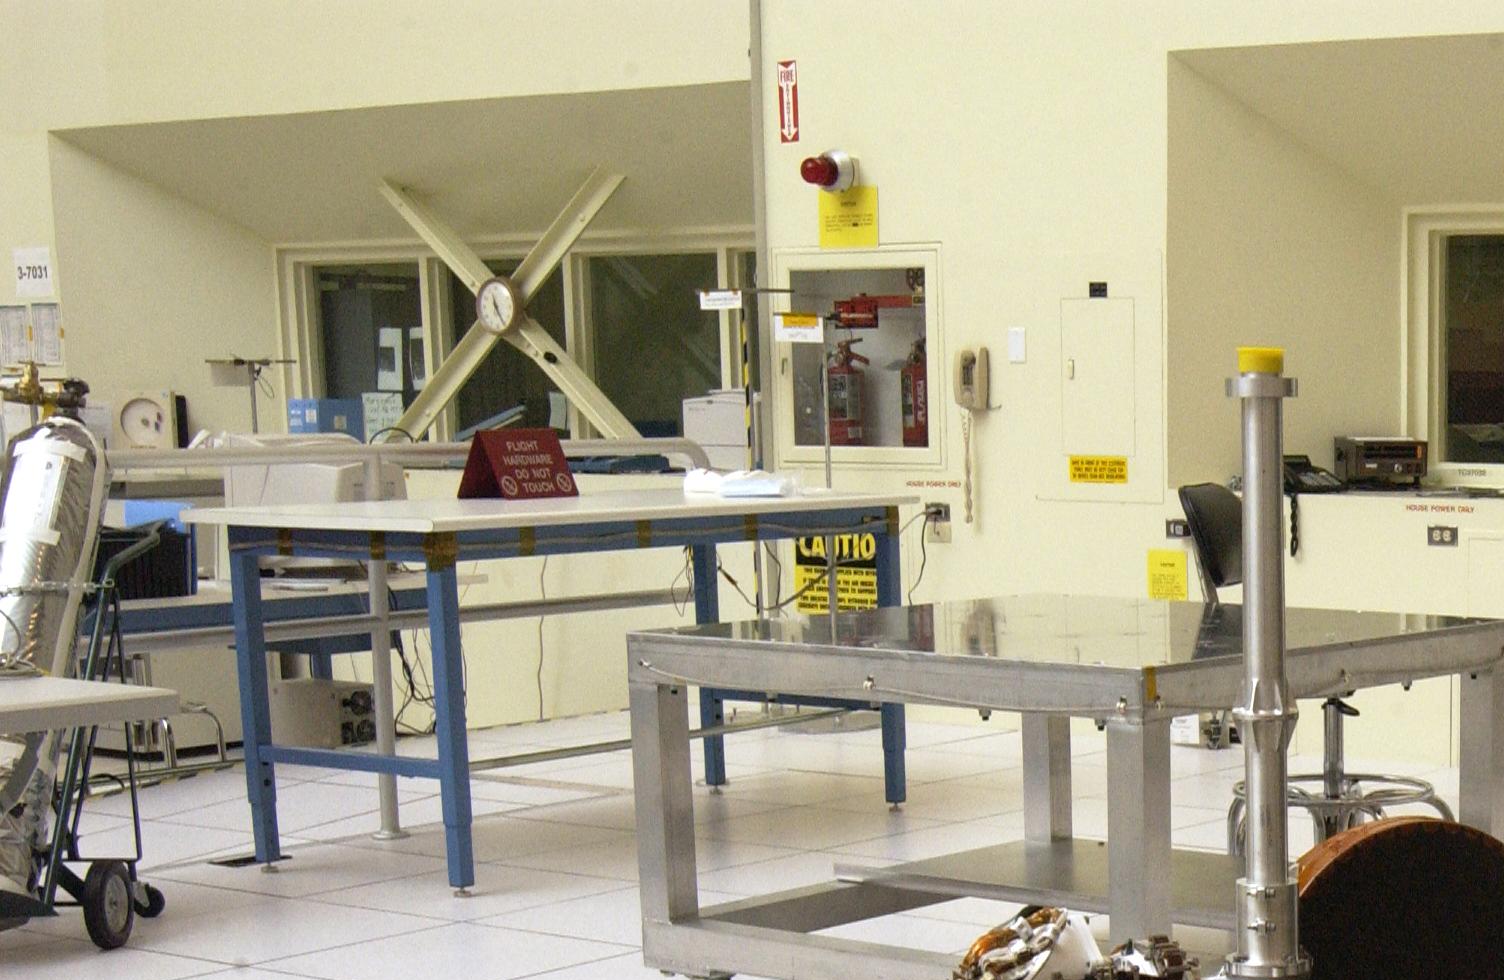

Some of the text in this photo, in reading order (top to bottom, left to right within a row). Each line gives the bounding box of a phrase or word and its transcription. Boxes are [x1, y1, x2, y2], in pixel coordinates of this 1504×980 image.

[17, 265, 48, 280] 3-7031
[506, 441, 538, 452] FLIGHT
[503, 453, 554, 465] HARDWARE
[514, 468, 551, 480] DO NOT
[522, 481, 555, 494] TOUCH
[1406, 504, 1429, 512] HOUSE
[1431, 504, 1456, 513] POWER
[799, 532, 876, 560] CAUTIO
